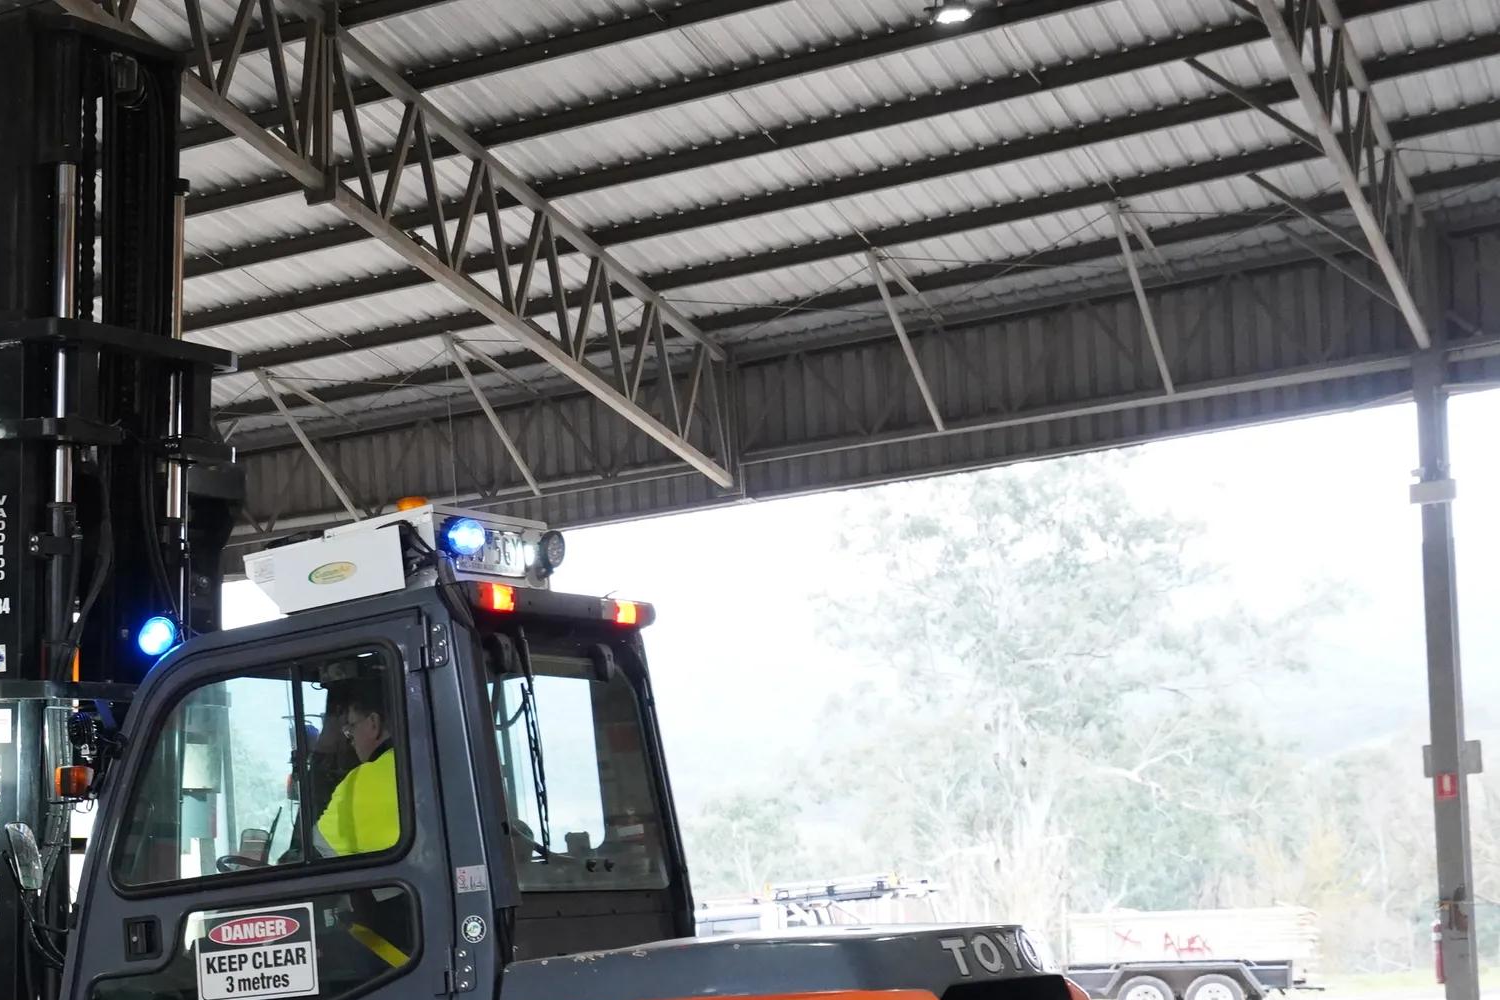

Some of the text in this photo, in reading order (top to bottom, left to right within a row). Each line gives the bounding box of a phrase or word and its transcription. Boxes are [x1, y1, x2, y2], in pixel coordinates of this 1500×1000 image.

[221, 919, 287, 942] DANGER
[206, 946, 307, 975] KEEP CLEAR
[226, 972, 290, 993] 3 metres
